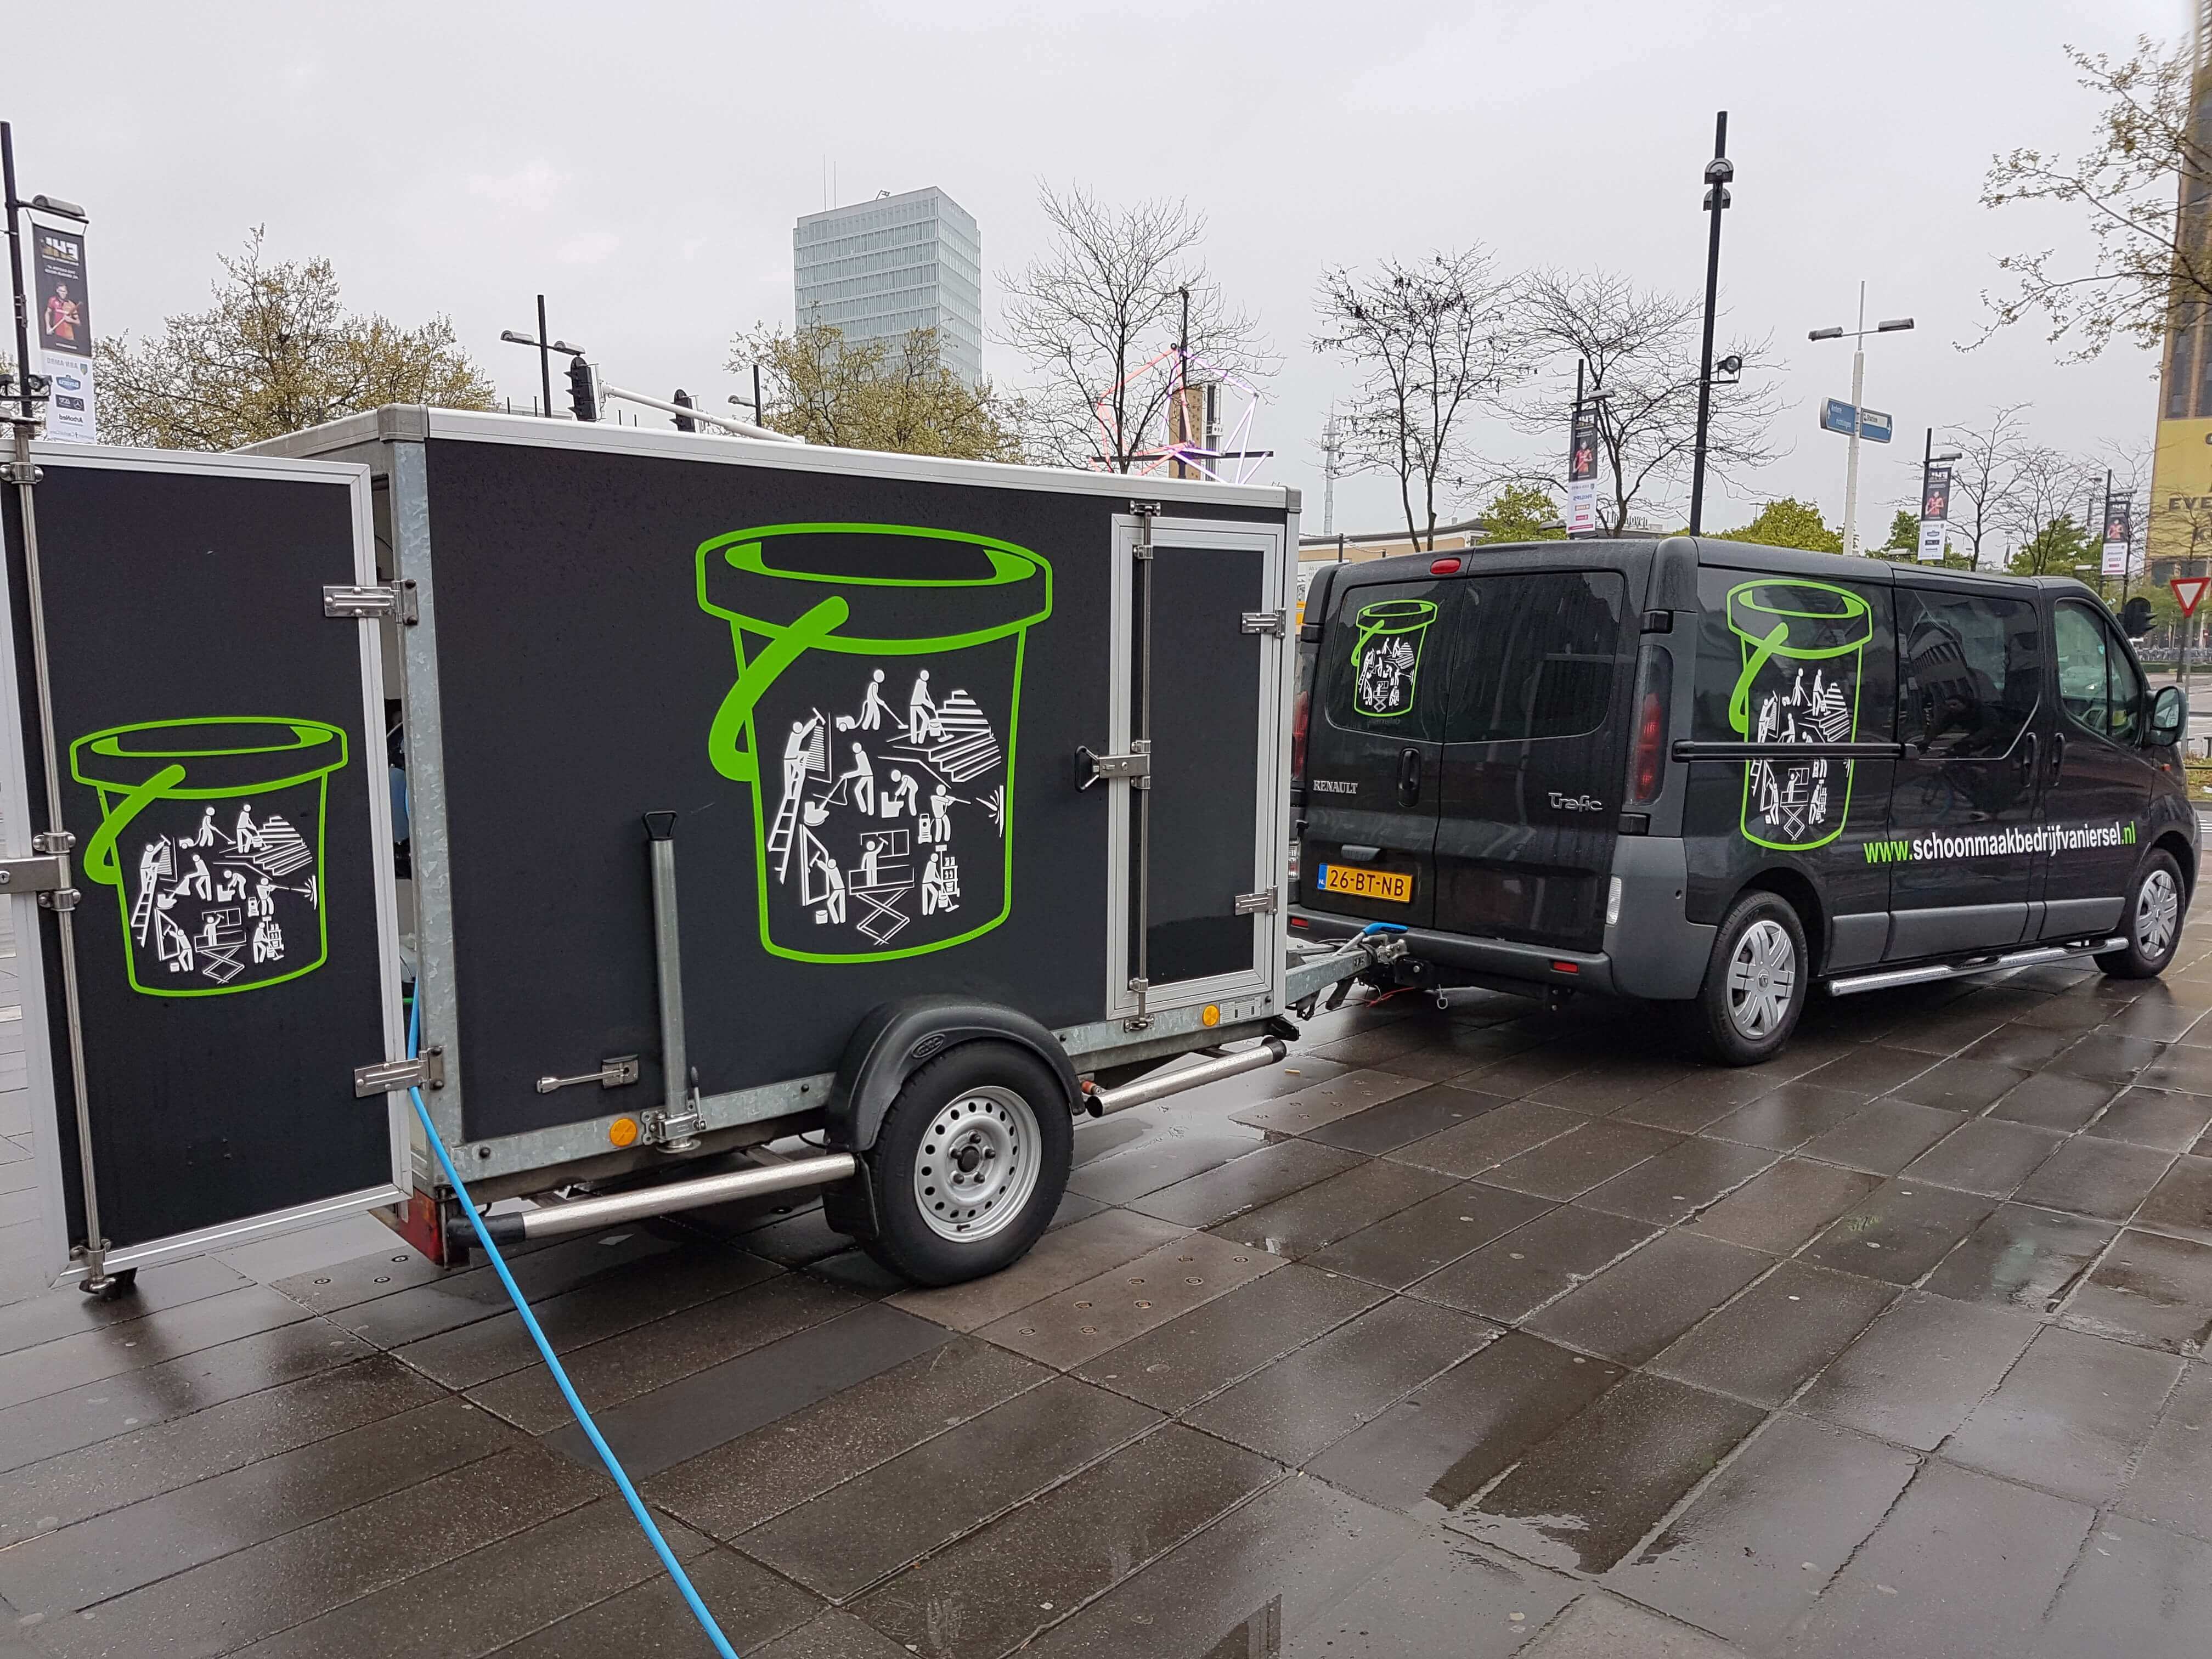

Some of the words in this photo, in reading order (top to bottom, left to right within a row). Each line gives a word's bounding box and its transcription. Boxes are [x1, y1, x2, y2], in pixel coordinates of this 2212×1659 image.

[1313, 780, 1358, 794] RENAULT
[1548, 792, 1603, 812] Trafic
[1863, 821, 2136, 864] www.schoonmaakbedrijfvaniersel.nl
[1329, 870, 1404, 896] 26-BT-NB
